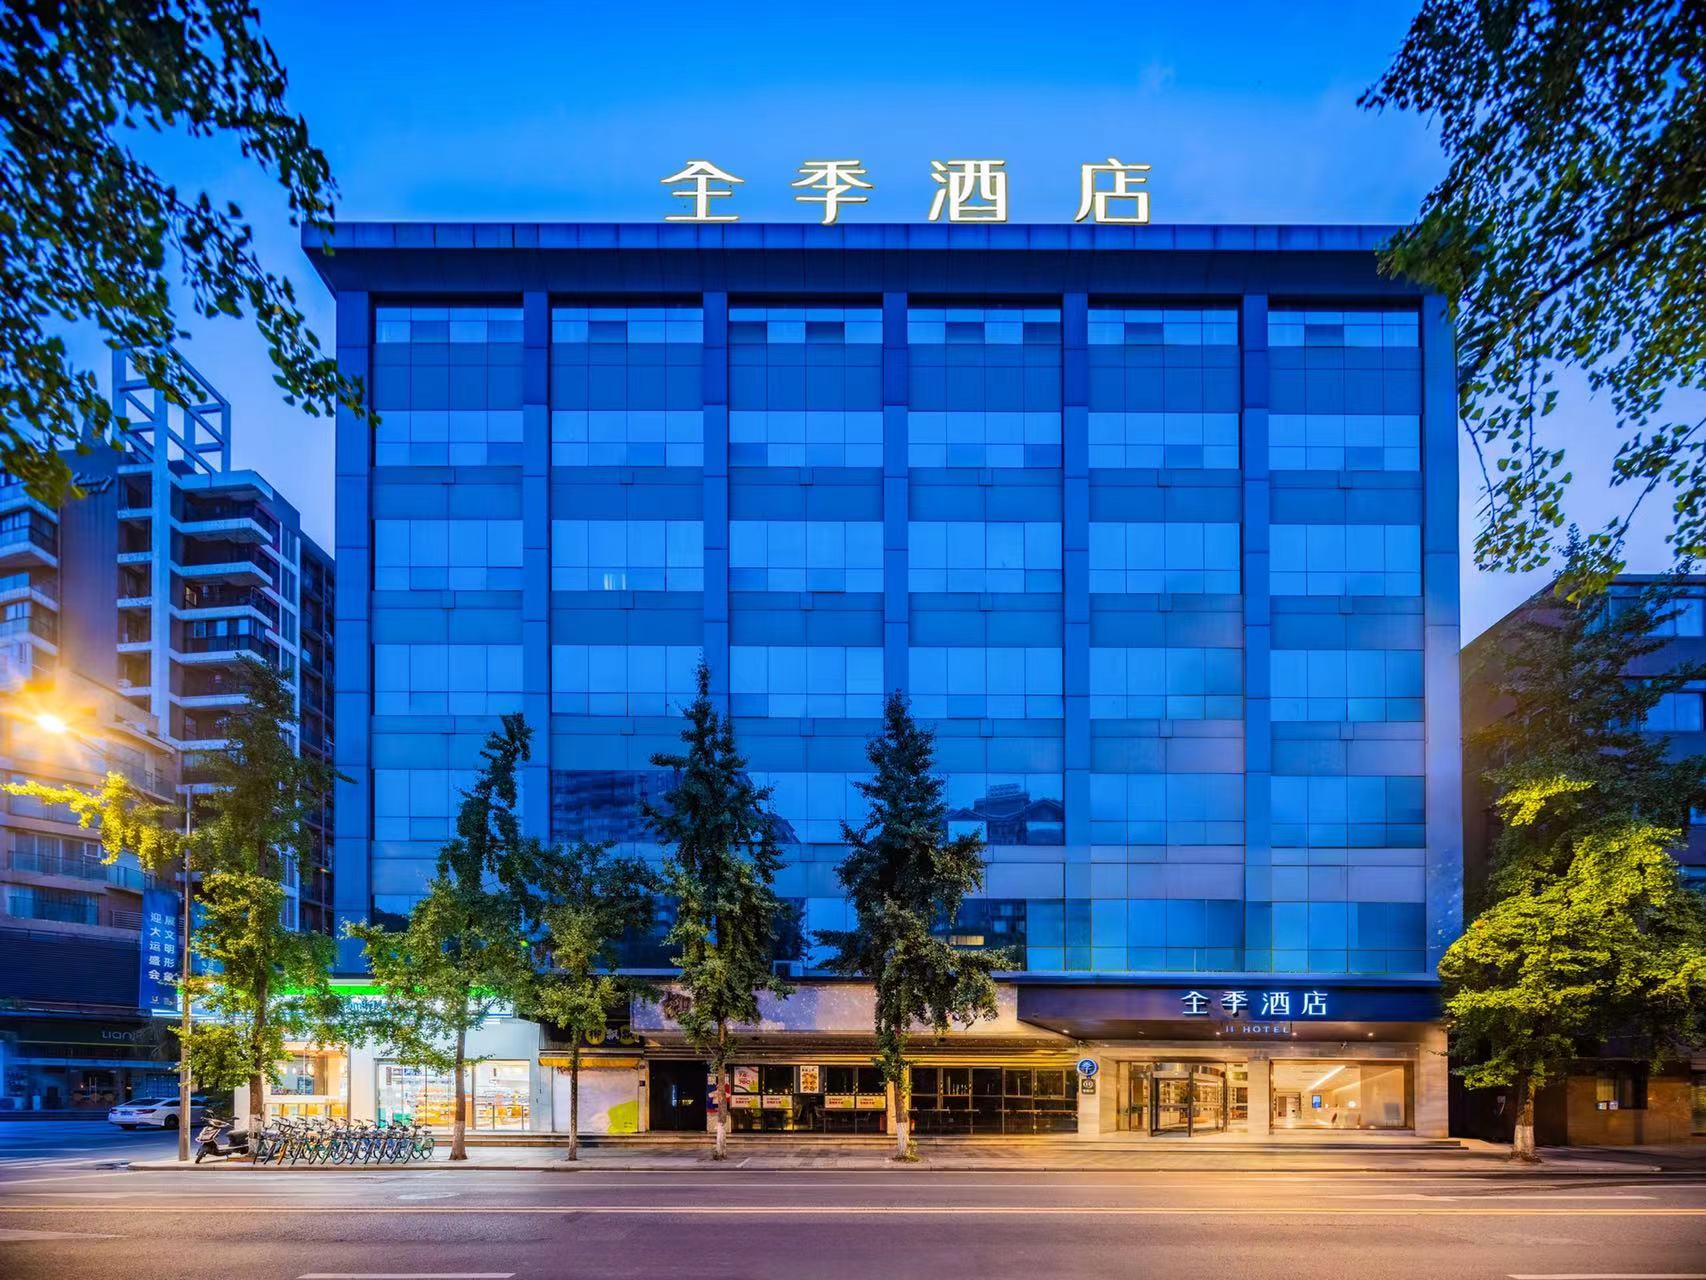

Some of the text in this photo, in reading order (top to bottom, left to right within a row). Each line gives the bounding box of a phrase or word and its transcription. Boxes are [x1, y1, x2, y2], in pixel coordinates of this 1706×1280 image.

[660, 157, 1151, 225] 全季酒店
[148, 911, 162, 980] 迎大运盛会
[1181, 990, 1328, 1015] 全季酒店
[1242, 1025, 1289, 1034] HOTEL
